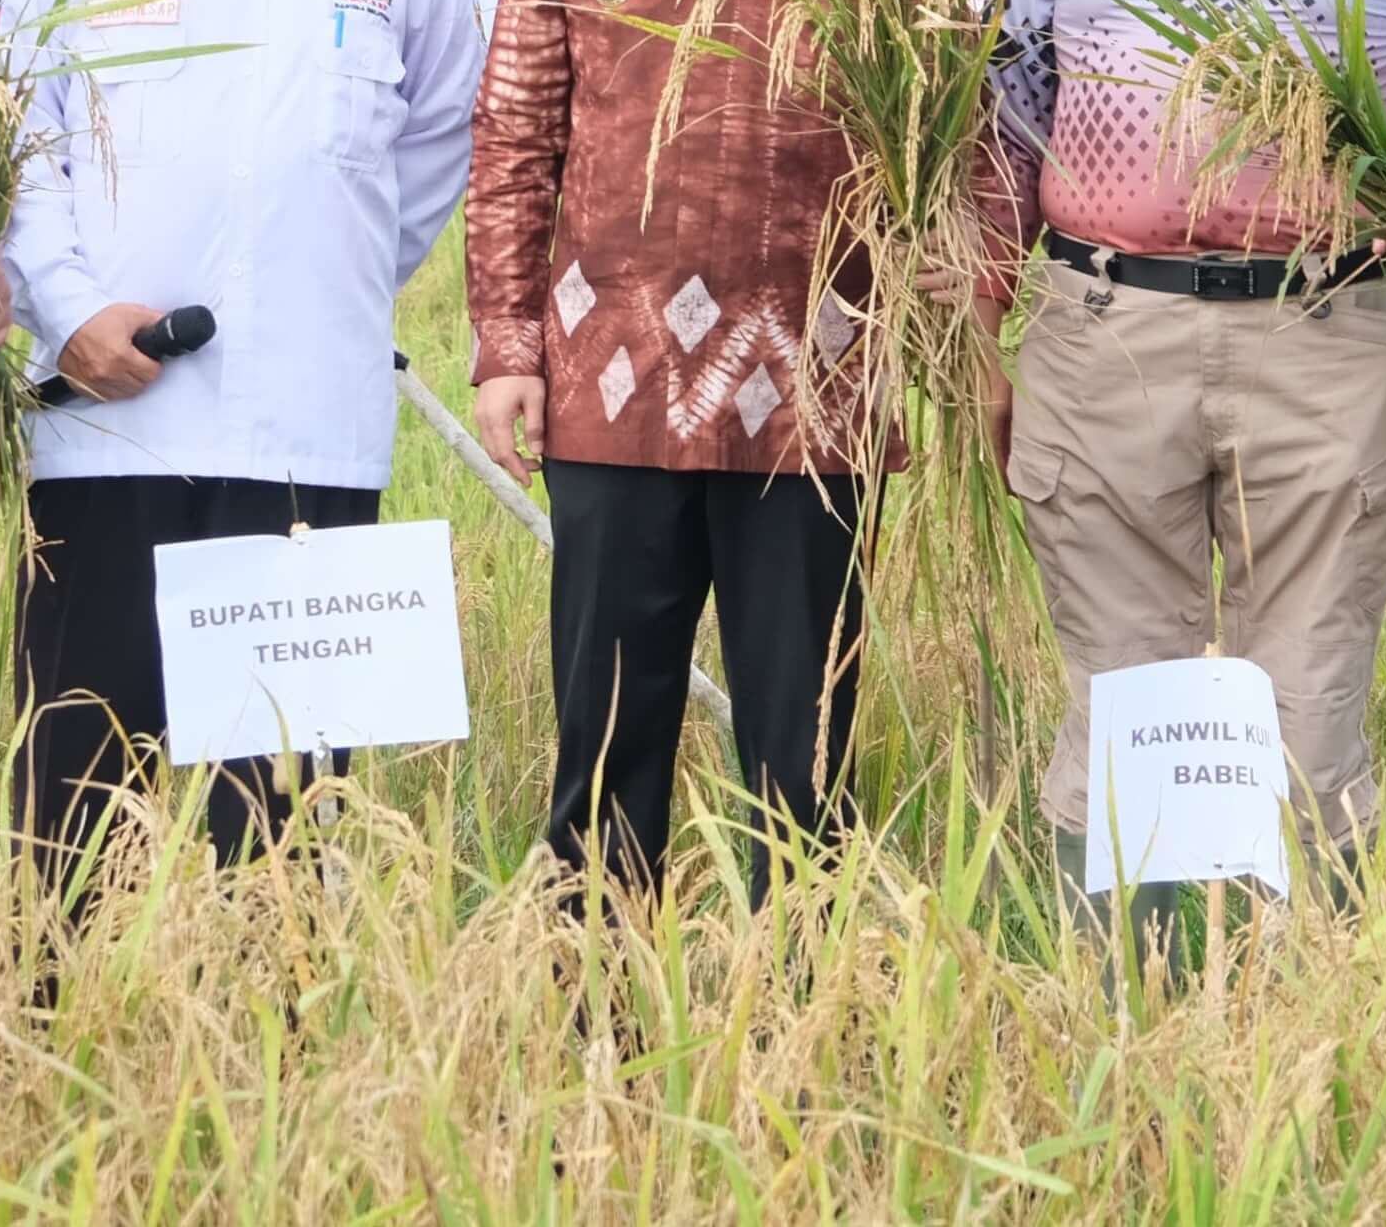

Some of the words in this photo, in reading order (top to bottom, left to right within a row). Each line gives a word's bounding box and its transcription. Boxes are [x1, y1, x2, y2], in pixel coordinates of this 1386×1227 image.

[189, 599, 294, 629] BUPATI
[304, 589, 426, 617] BANGKA
[253, 635, 373, 664] TENGAH
[1131, 721, 1238, 748] KANWIL
[1173, 764, 1260, 787] BABEL
